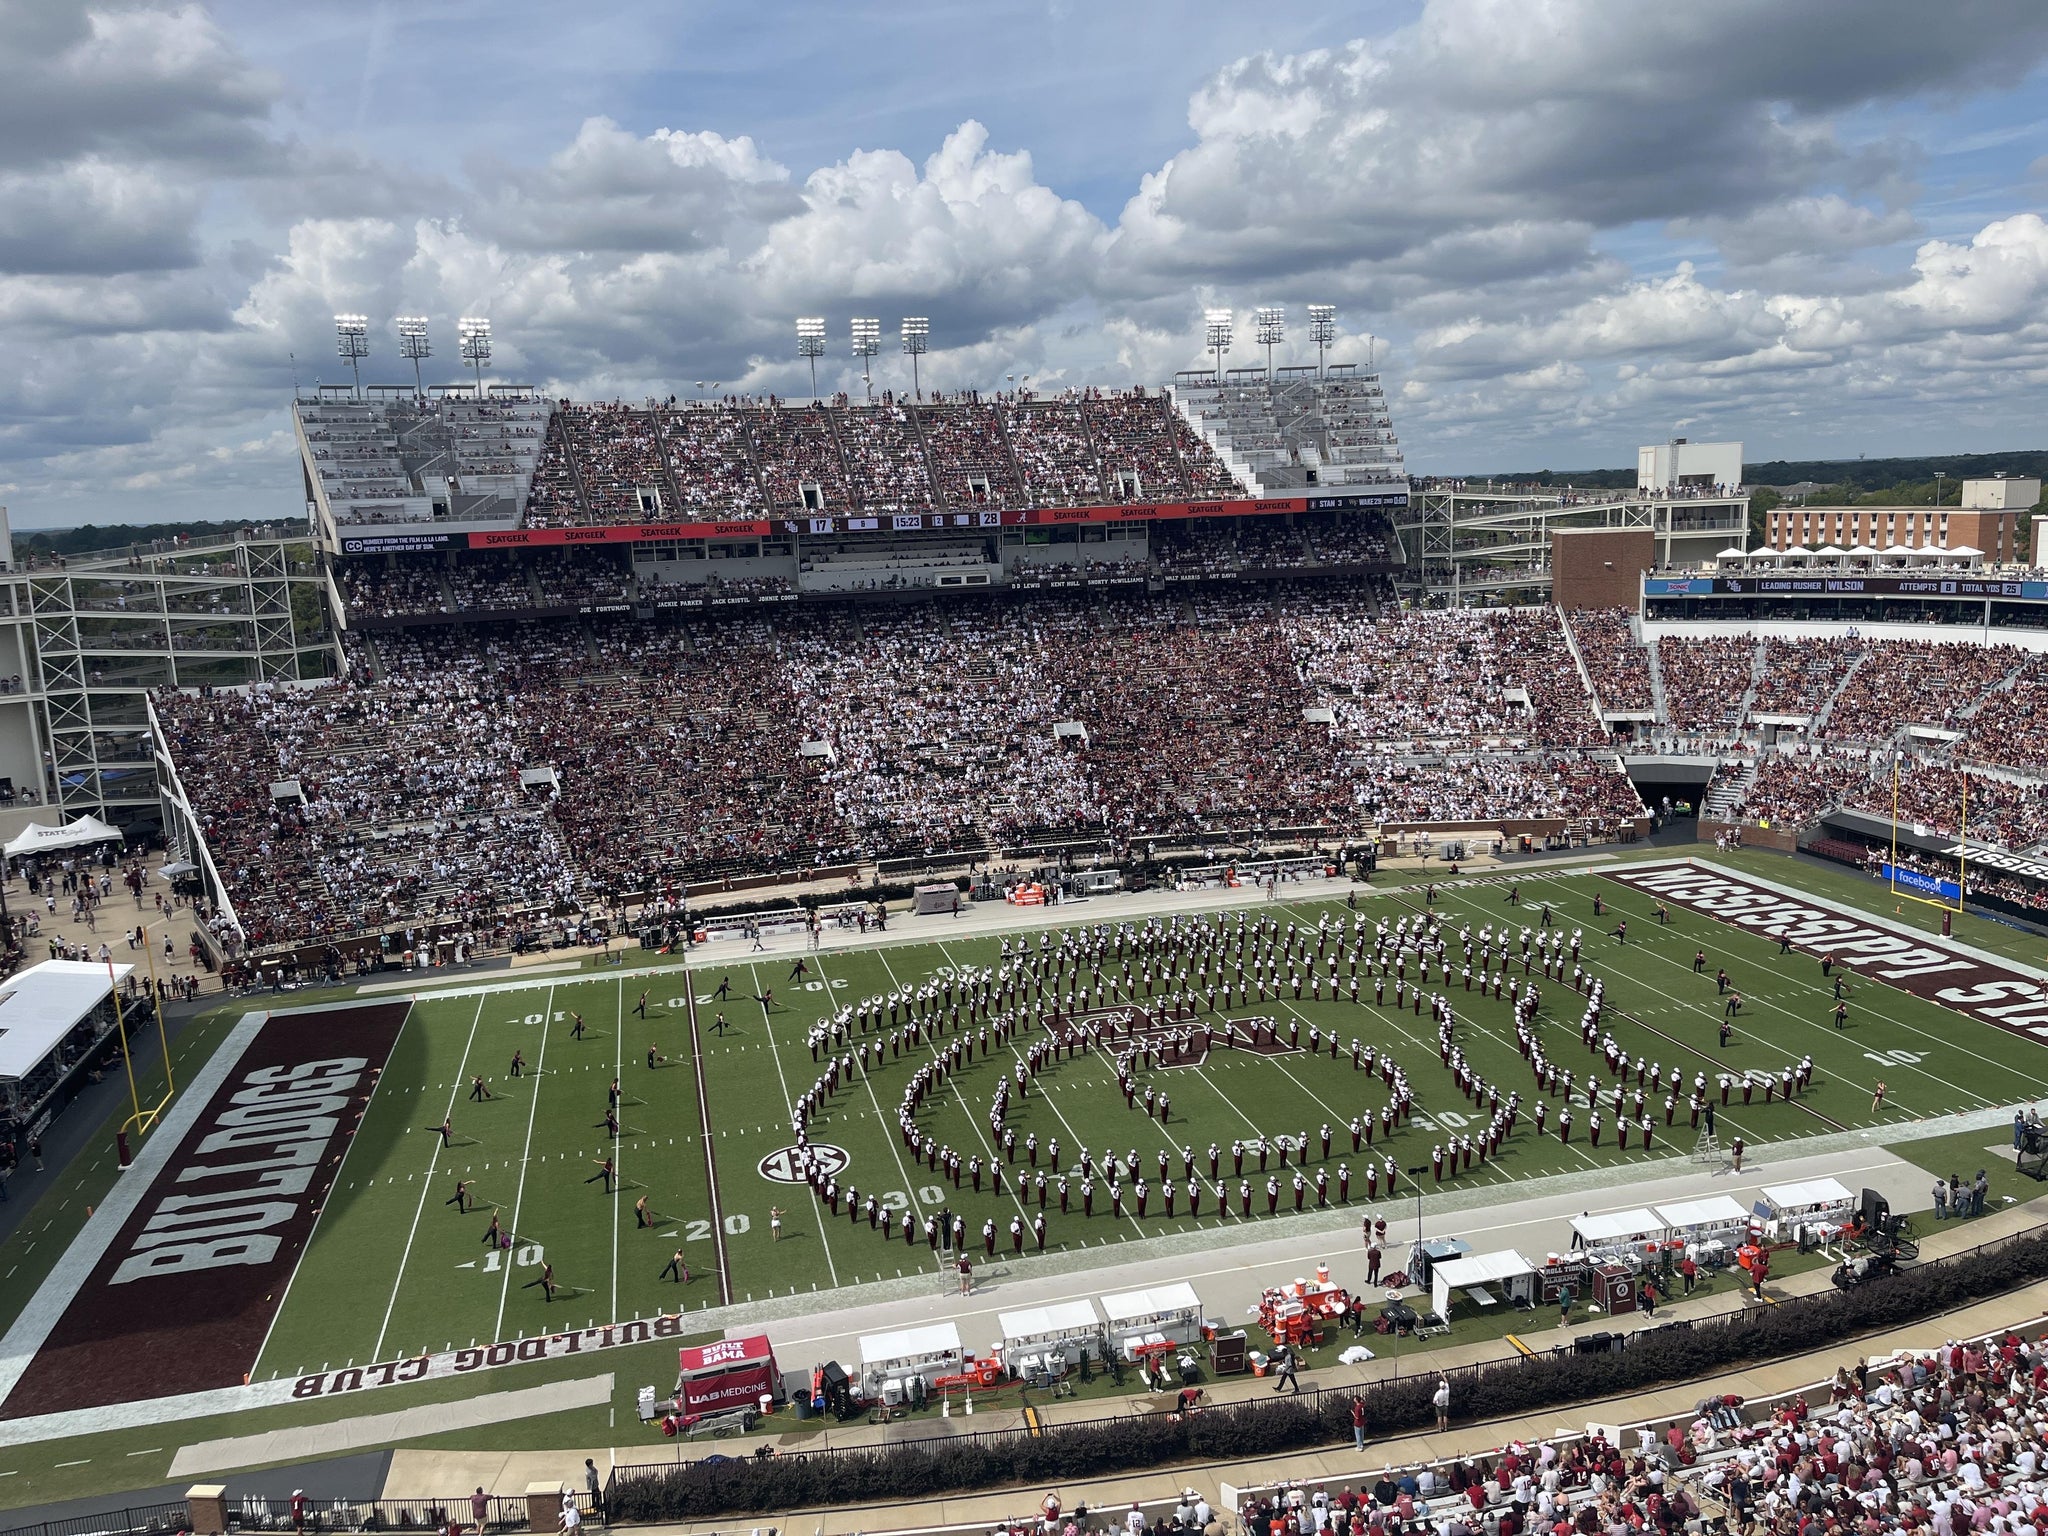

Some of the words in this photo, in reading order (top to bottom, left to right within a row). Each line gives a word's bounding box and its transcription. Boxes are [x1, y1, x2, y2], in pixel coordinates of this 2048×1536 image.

[1188, 504, 1224, 514] SEATGEEK
[1254, 502, 1290, 511] SEATGEEK
[1320, 500, 1335, 508] STAN
[1054, 510, 1090, 520] SEATGEEK
[1121, 508, 1156, 517] SEATGEEK
[895, 516, 920, 528] 15:23
[984, 513, 998, 524] 28
[714, 524, 754, 534] SEATGEEK
[815, 520, 827, 532] 17
[564, 530, 606, 541] SEATGEEK
[640, 527, 681, 538] SEATGEEK
[486, 534, 529, 544] SEATGEEK
[346, 541, 362, 551] CC
[1761, 582, 1790, 590] LEADING
[1793, 582, 1821, 590] RUSHER
[1828, 581, 1864, 591] WILSON
[1899, 582, 1937, 591] ATTEMPTS
[1961, 583, 1983, 592] TOTAL
[2007, 584, 2016, 593] 25
[38, 830, 66, 838] STATE
[1900, 871, 1942, 892] facebook
[1617, 868, 1978, 980] MISSISSIPPI
[1863, 1050, 1922, 1067] 10
[1411, 1111, 1469, 1131] 40
[108, 1056, 368, 1286] BULLDOGS
[882, 1185, 945, 1210] 30
[685, 1214, 750, 1242] 20
[482, 1244, 544, 1273] 10
[1546, 1267, 1562, 1275] ROLL
[1324, 1293, 1335, 1304] G
[454, 1316, 682, 1372] BULLDOG
[702, 1342, 744, 1355] BUILT
[703, 1350, 745, 1365] BAMA
[292, 1357, 429, 1399] CLUB
[983, 1371, 992, 1381] G
[689, 1392, 720, 1404] UAB
[720, 1382, 767, 1398] MEDICINE
[1930, 1459, 1940, 1471] 16
[1576, 1471, 1587, 1481] 14
